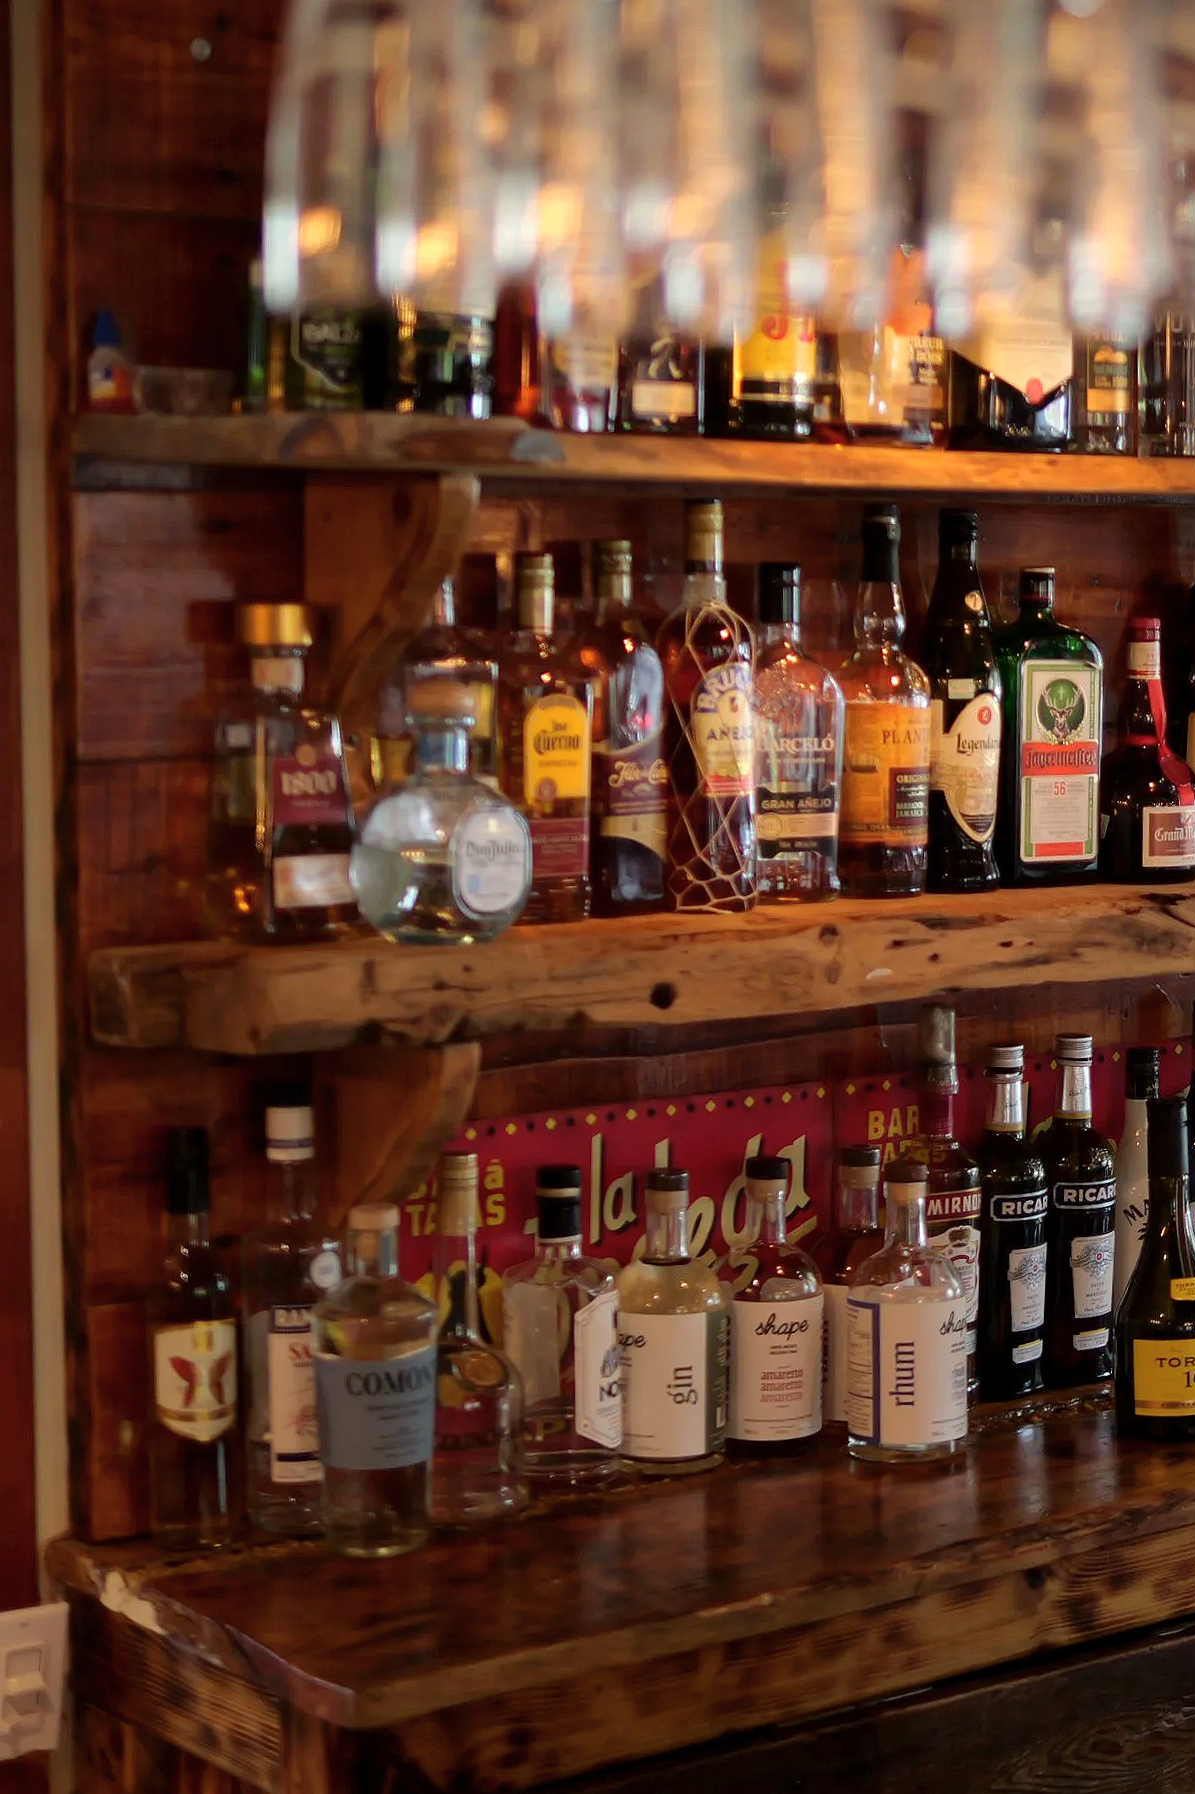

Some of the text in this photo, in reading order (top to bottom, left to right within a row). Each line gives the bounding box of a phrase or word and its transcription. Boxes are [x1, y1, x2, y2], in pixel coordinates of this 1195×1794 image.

[280, 770, 337, 795] 1800
[761, 799, 795, 810] GRAN
[927, 1192, 982, 1217] MIRNO
[755, 1312, 809, 1341] shape
[667, 1365, 698, 1405] gin
[889, 1341, 914, 1407] rhum
